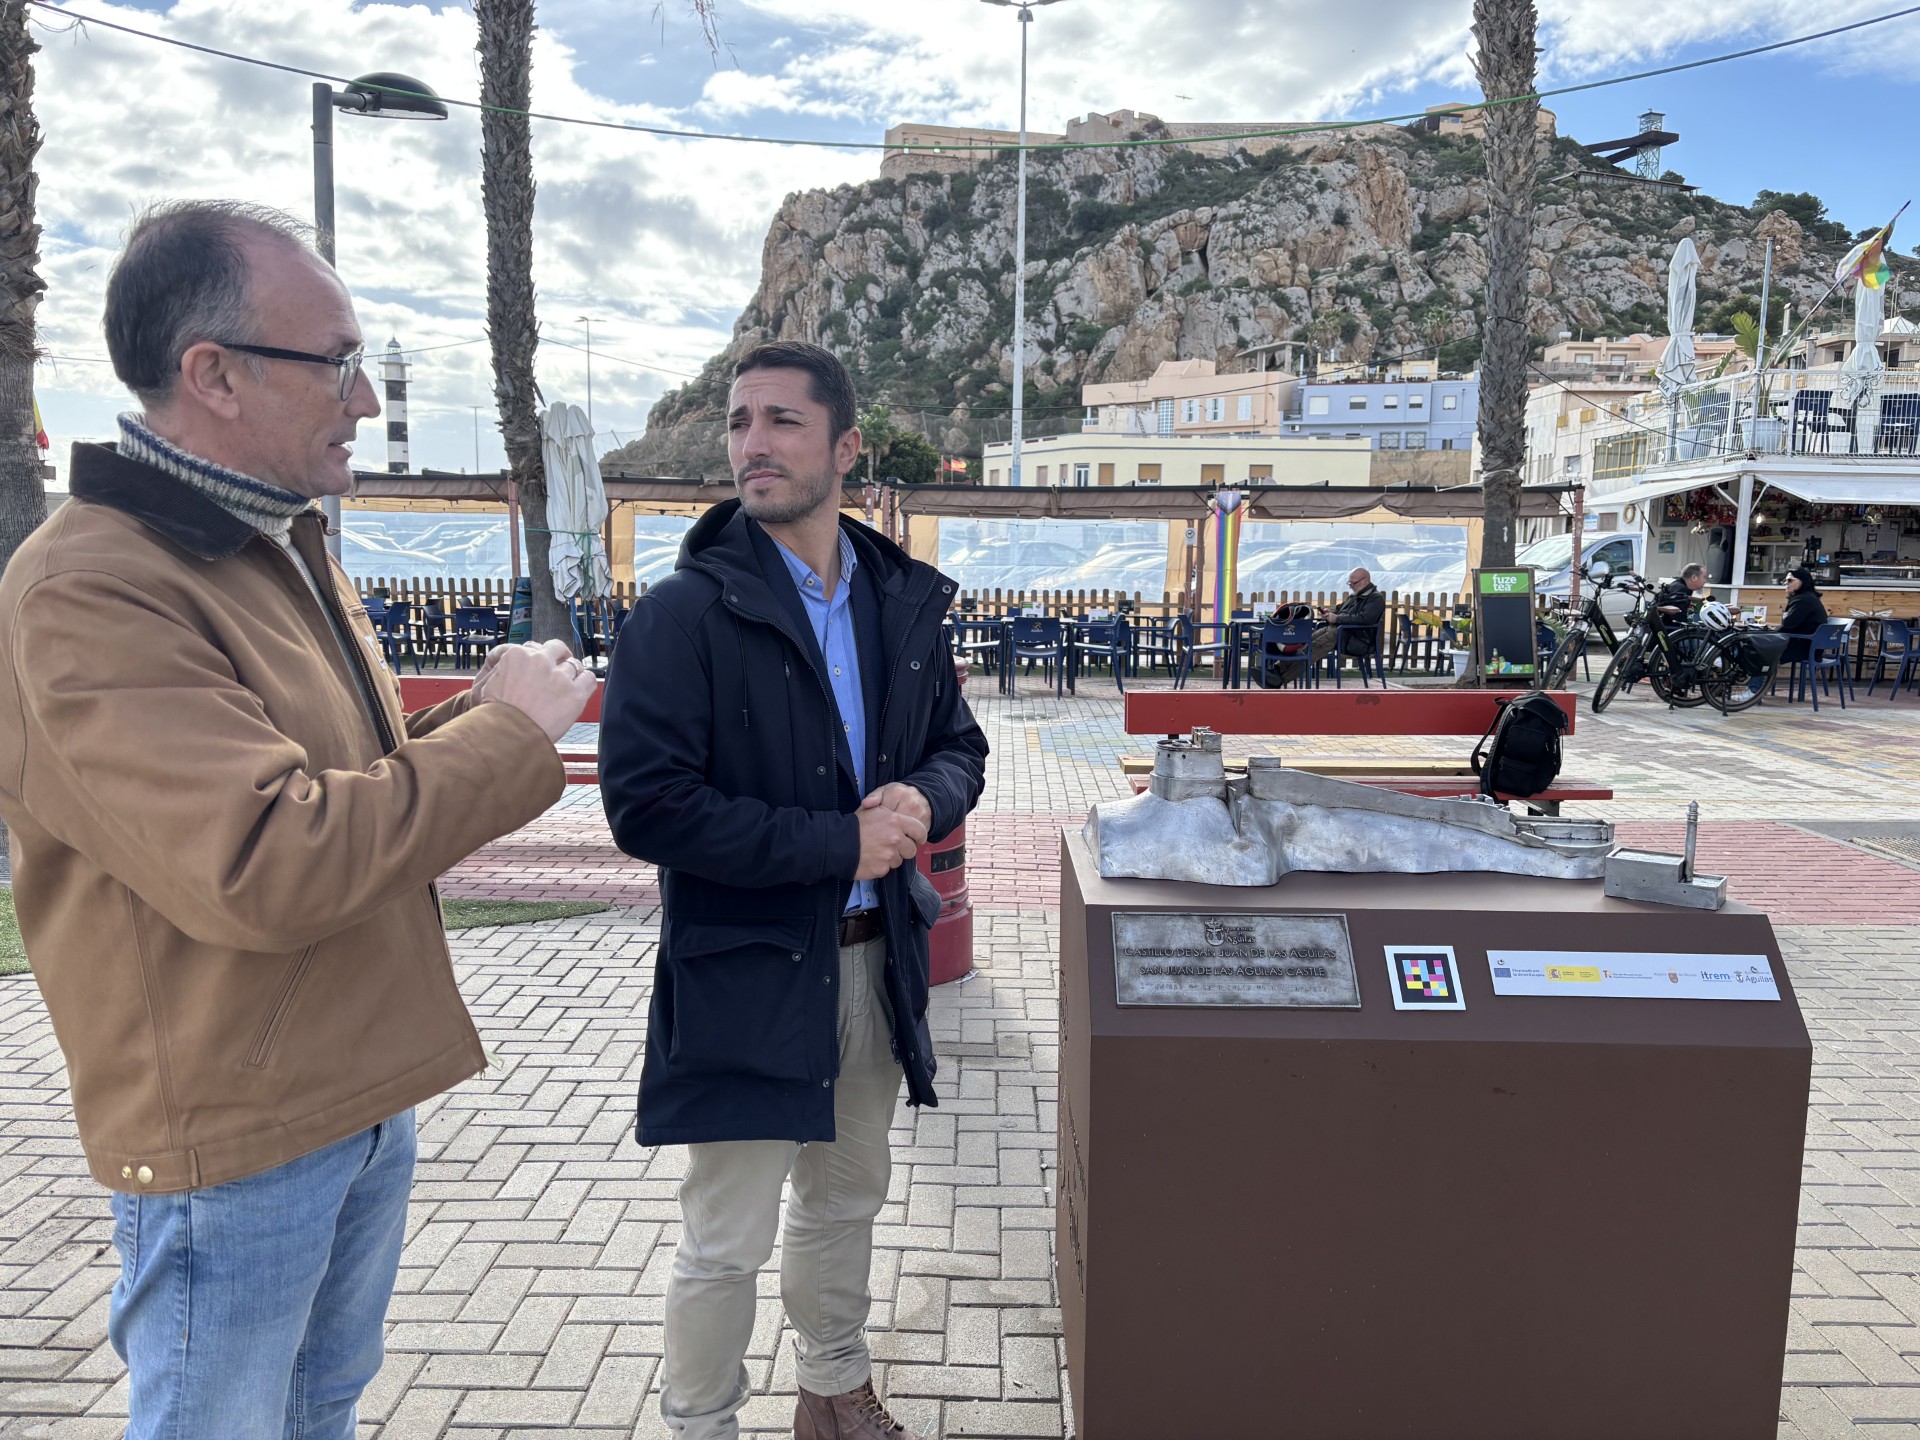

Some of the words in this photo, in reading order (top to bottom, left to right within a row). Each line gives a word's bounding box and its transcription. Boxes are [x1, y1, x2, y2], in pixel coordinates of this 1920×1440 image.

[1492, 573, 1517, 585] fuze
[1493, 583, 1512, 592] tea
[1124, 948, 1173, 957] CASTILLO
[1176, 948, 1191, 957] DE
[1193, 948, 1216, 957] SAN
[1219, 948, 1248, 957] JUAN
[1250, 949, 1266, 957] DE
[1268, 949, 1287, 958] LAS
[1139, 966, 1162, 975] SAN
[1165, 966, 1193, 975] JUAN
[1196, 966, 1212, 975] DE
[1214, 966, 1233, 975] LAS
[1286, 967, 1325, 977] CASTLE
[1700, 970, 1731, 980] itrem
